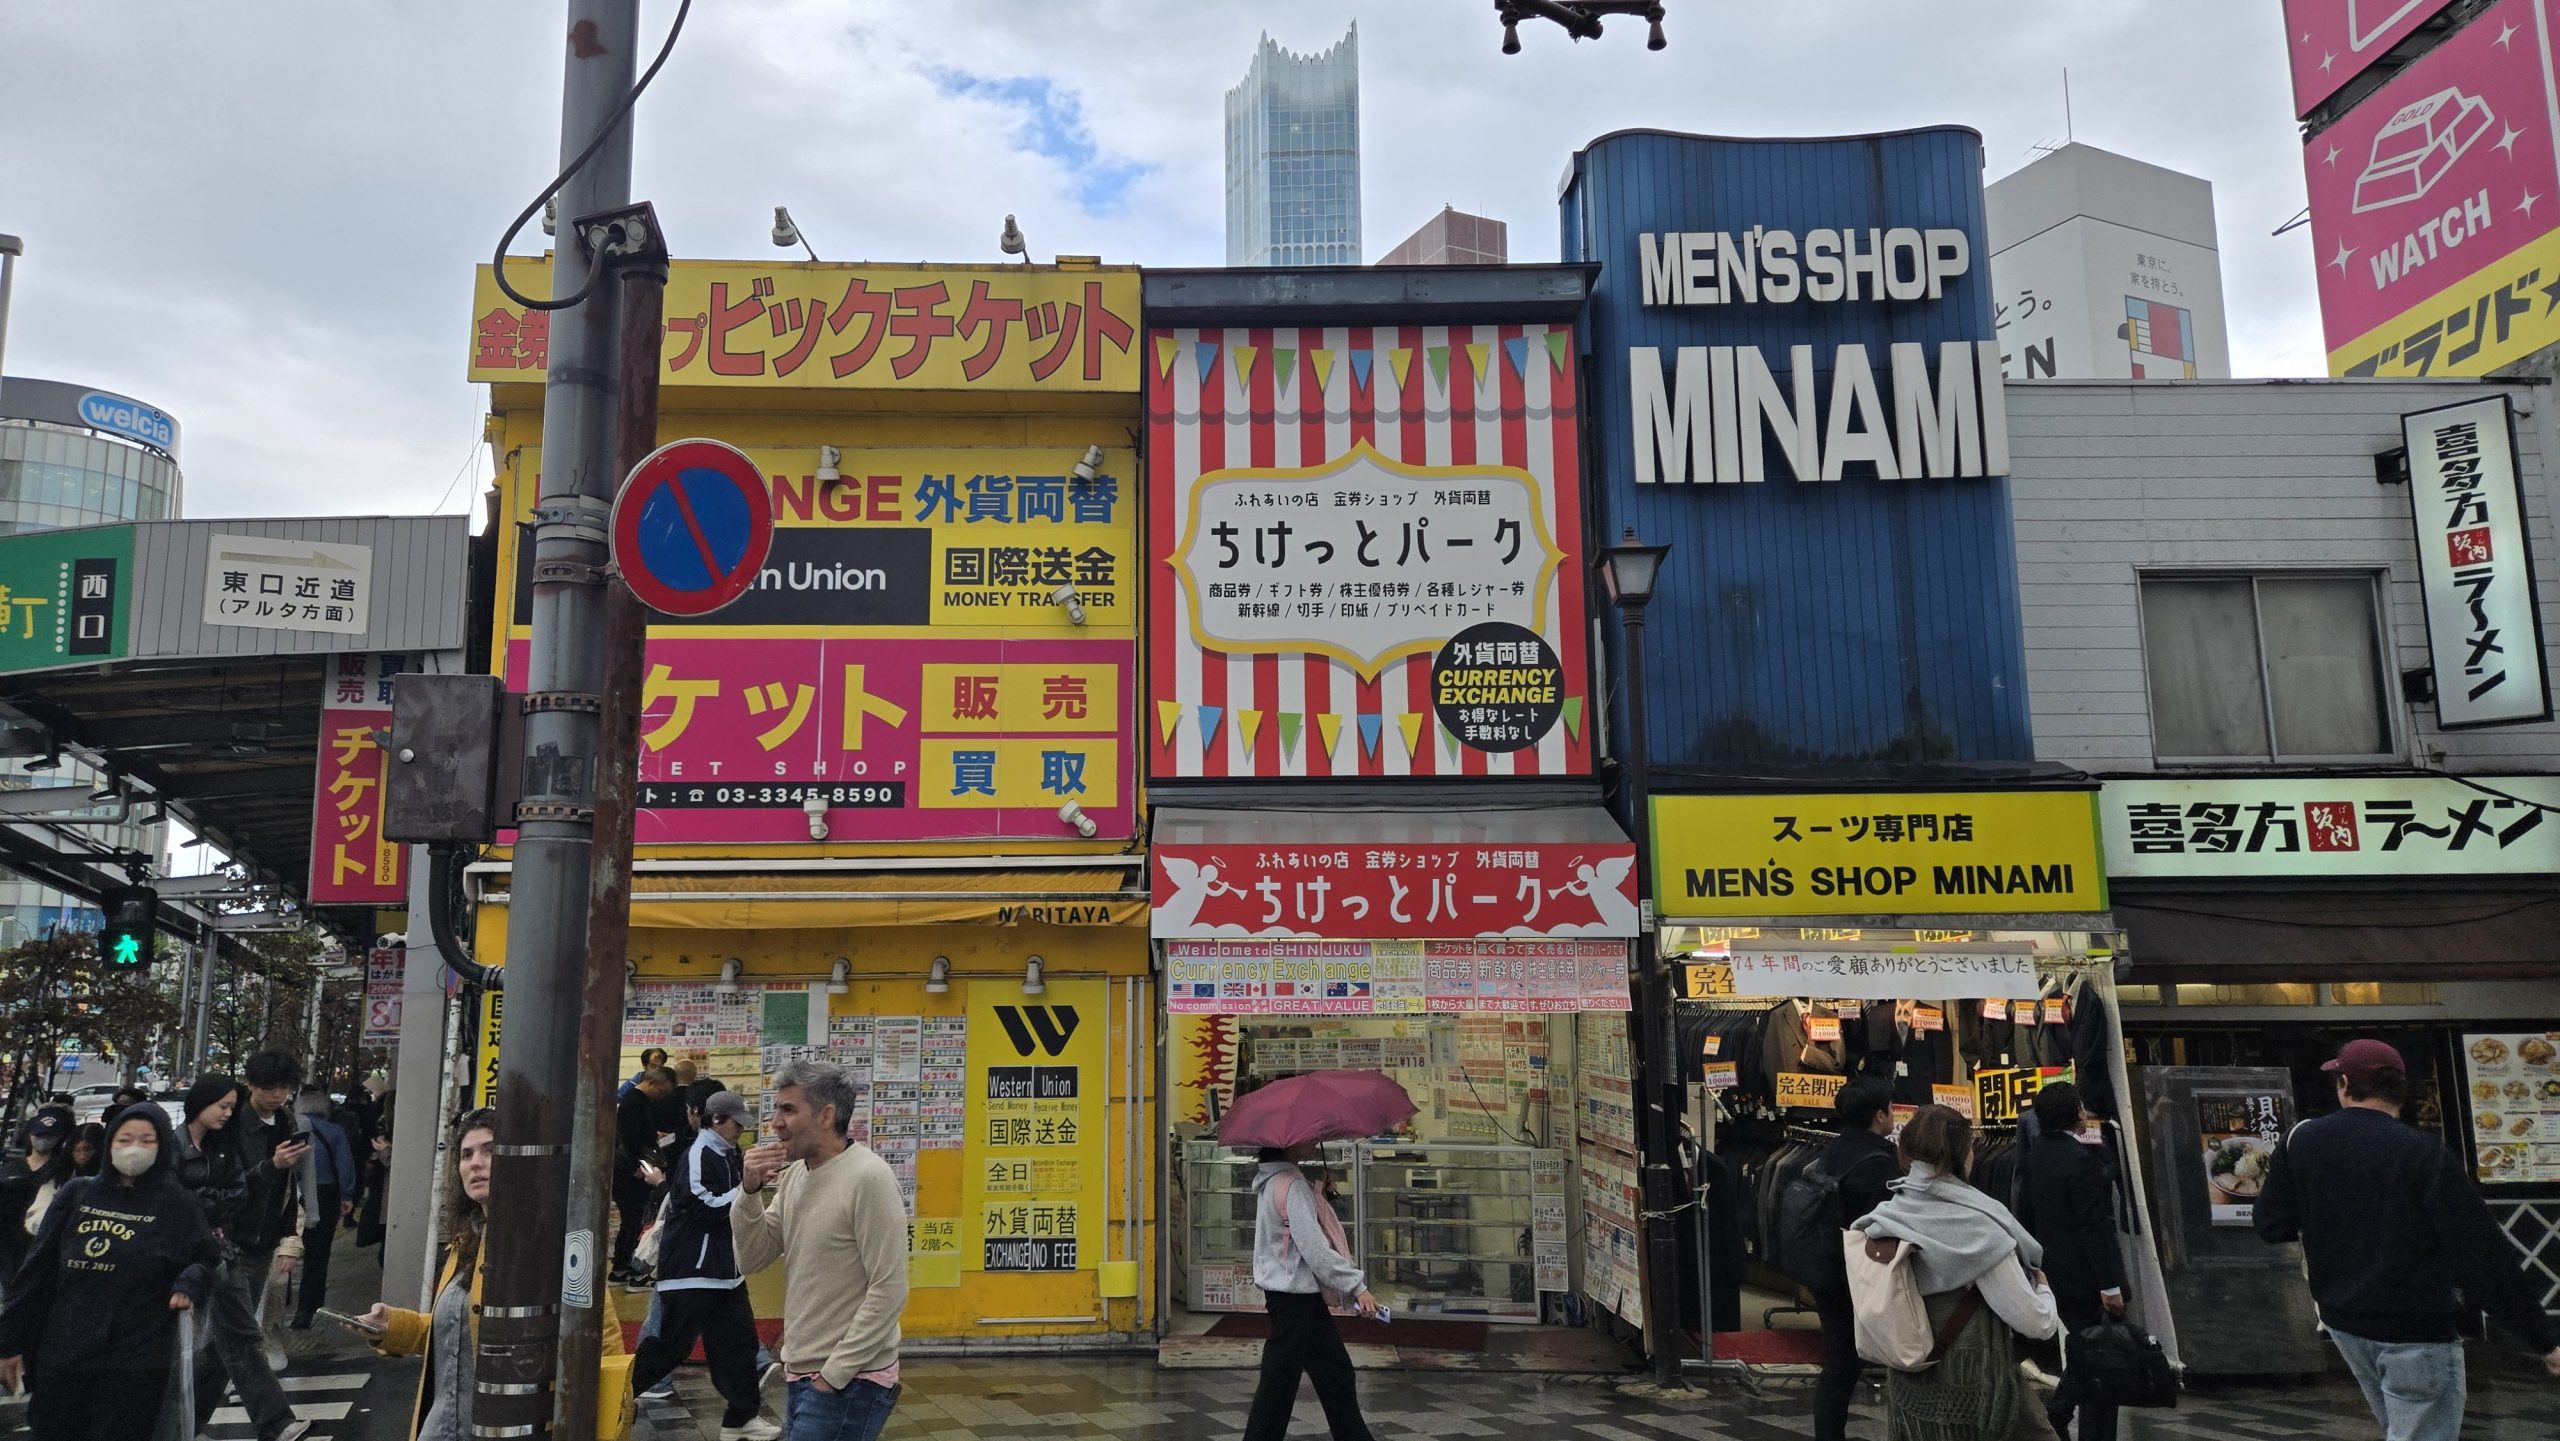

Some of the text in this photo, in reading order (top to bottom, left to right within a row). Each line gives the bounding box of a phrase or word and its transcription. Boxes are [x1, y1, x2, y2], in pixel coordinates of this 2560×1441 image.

[2392, 102, 2435, 127] GOLD
[2370, 188, 2492, 290] WATCH
[1639, 224, 1970, 306] MEN'S SHOP
[2130, 272, 2184, 298] 家を持とう。
[707, 276, 1135, 382] ビックチケット
[88, 400, 170, 443] welcia
[1629, 340, 2011, 484] MINAMI
[2433, 421, 2489, 529] 喜多方
[771, 474, 903, 522] NGE
[914, 473, 1119, 524] 外貨両替
[1234, 489, 1492, 508] ふれあいの店 金券ショップ 外貨両替
[1210, 516, 1522, 569] ちけっとパーク
[788, 561, 886, 591] Union
[945, 546, 1117, 586] 国際送金
[222, 570, 356, 602] 東口近道
[1208, 580, 1525, 599] 商品券 ギフト券 株主優待券 各種レジャー券
[79, 573, 109, 640] 西口
[943, 591, 1115, 607] MONEY TRASFER
[1237, 602, 1280, 618] 新幹線
[1297, 602, 1325, 618] 切手
[1340, 602, 1369, 618] 印紙
[1453, 641, 1540, 667] 外貨両替
[336, 653, 366, 704] 販売
[1438, 667, 1557, 687] CURRENCY
[952, 675, 1089, 720] 販売
[1438, 686, 1556, 705] EXCHANGE
[641, 663, 908, 753] ケット
[1458, 707, 1540, 723] お得なレート
[1464, 723, 1533, 741] 手数料なし
[774, 761, 906, 776] SHOP
[951, 749, 1088, 796] 買取
[327, 725, 378, 886] チケット
[716, 787, 893, 804] 03-3345-8590
[1772, 813, 1974, 843] スーツ専門店
[2126, 801, 2301, 854] 喜多方
[1255, 849, 1540, 870] ふれあいの店 金券ショップ 外貨両替
[1685, 857, 2074, 898] MEN'S SHOP MINAMI
[1254, 873, 1542, 925] ちけっとパーク
[1178, 944, 1251, 957] Welcome
[1255, 945, 1270, 957] to
[1434, 943, 1473, 955] チケットを
[1477, 943, 1524, 955] 高く買って
[1527, 943, 1574, 955] 安く売る店
[1171, 959, 1269, 982] Currency
[1273, 958, 1371, 982] Exchange
[1427, 960, 1472, 980] 商品券
[1478, 960, 1524, 980] 新幹線
[1528, 960, 1574, 980] 株主優待券
[1579, 960, 1626, 981] レジャー券
[1169, 1001, 1184, 1010] No
[1274, 1000, 1320, 1011] GREAT
[1325, 999, 1369, 1011] VALUE
[1478, 999, 1526, 1011] まで大歓迎で
[1400, 1056, 1425, 1068] ¥118
[989, 1074, 1071, 1098] Western Union
[1779, 1075, 1845, 1097] 完全閉店
[987, 1100, 1078, 1113] Send Money Receive Money
[989, 1116, 1078, 1146] 国際送金
[989, 1162, 1027, 1182] 全日
[78, 1219, 136, 1241] GINOS
[923, 1221, 955, 1235] 当店
[987, 1205, 1077, 1236] 外貨両替
[921, 1237, 955, 1252] 2階へ
[985, 1243, 1077, 1268] EXCHANGE NO FEE
[67, 1259, 116, 1272] EST. 2017
